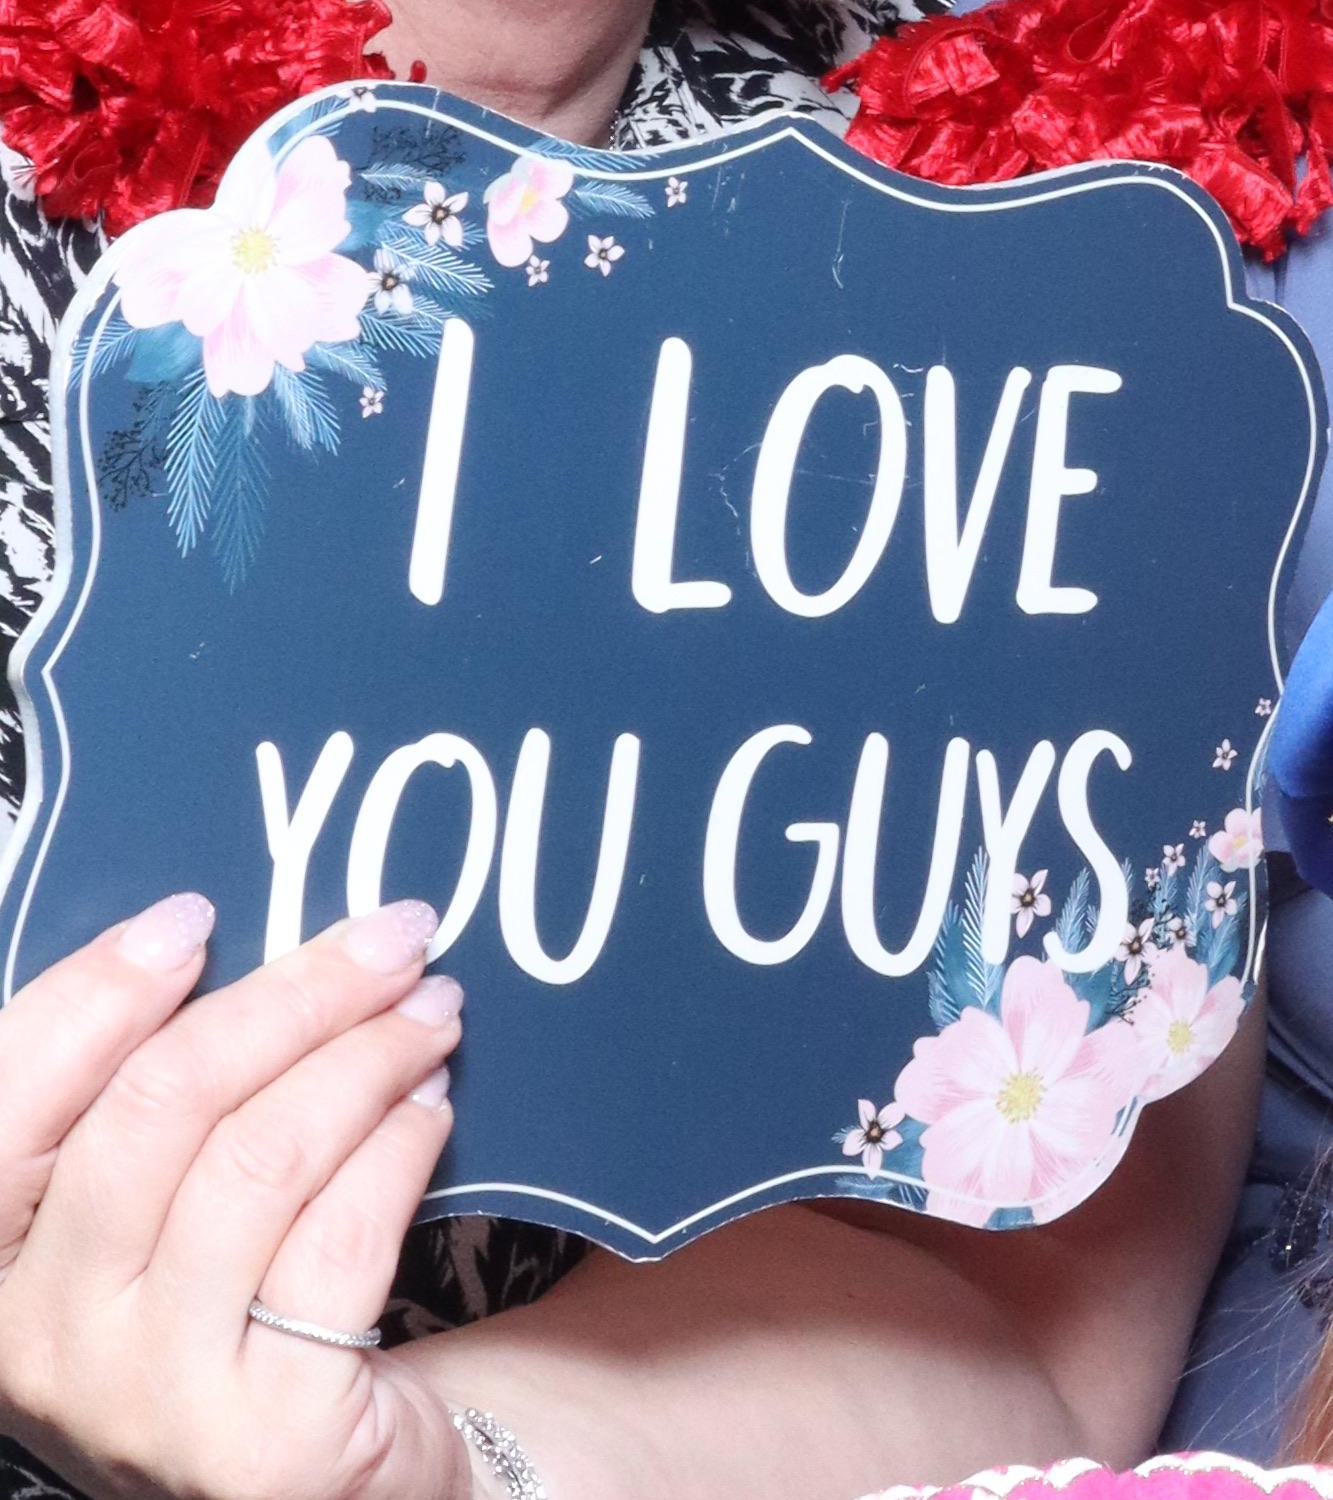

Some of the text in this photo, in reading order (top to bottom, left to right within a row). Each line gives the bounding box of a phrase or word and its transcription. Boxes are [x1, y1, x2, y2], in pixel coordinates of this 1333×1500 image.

[410, 318, 1122, 623] I LOVE
[255, 725, 1132, 984] YOU GUYS
